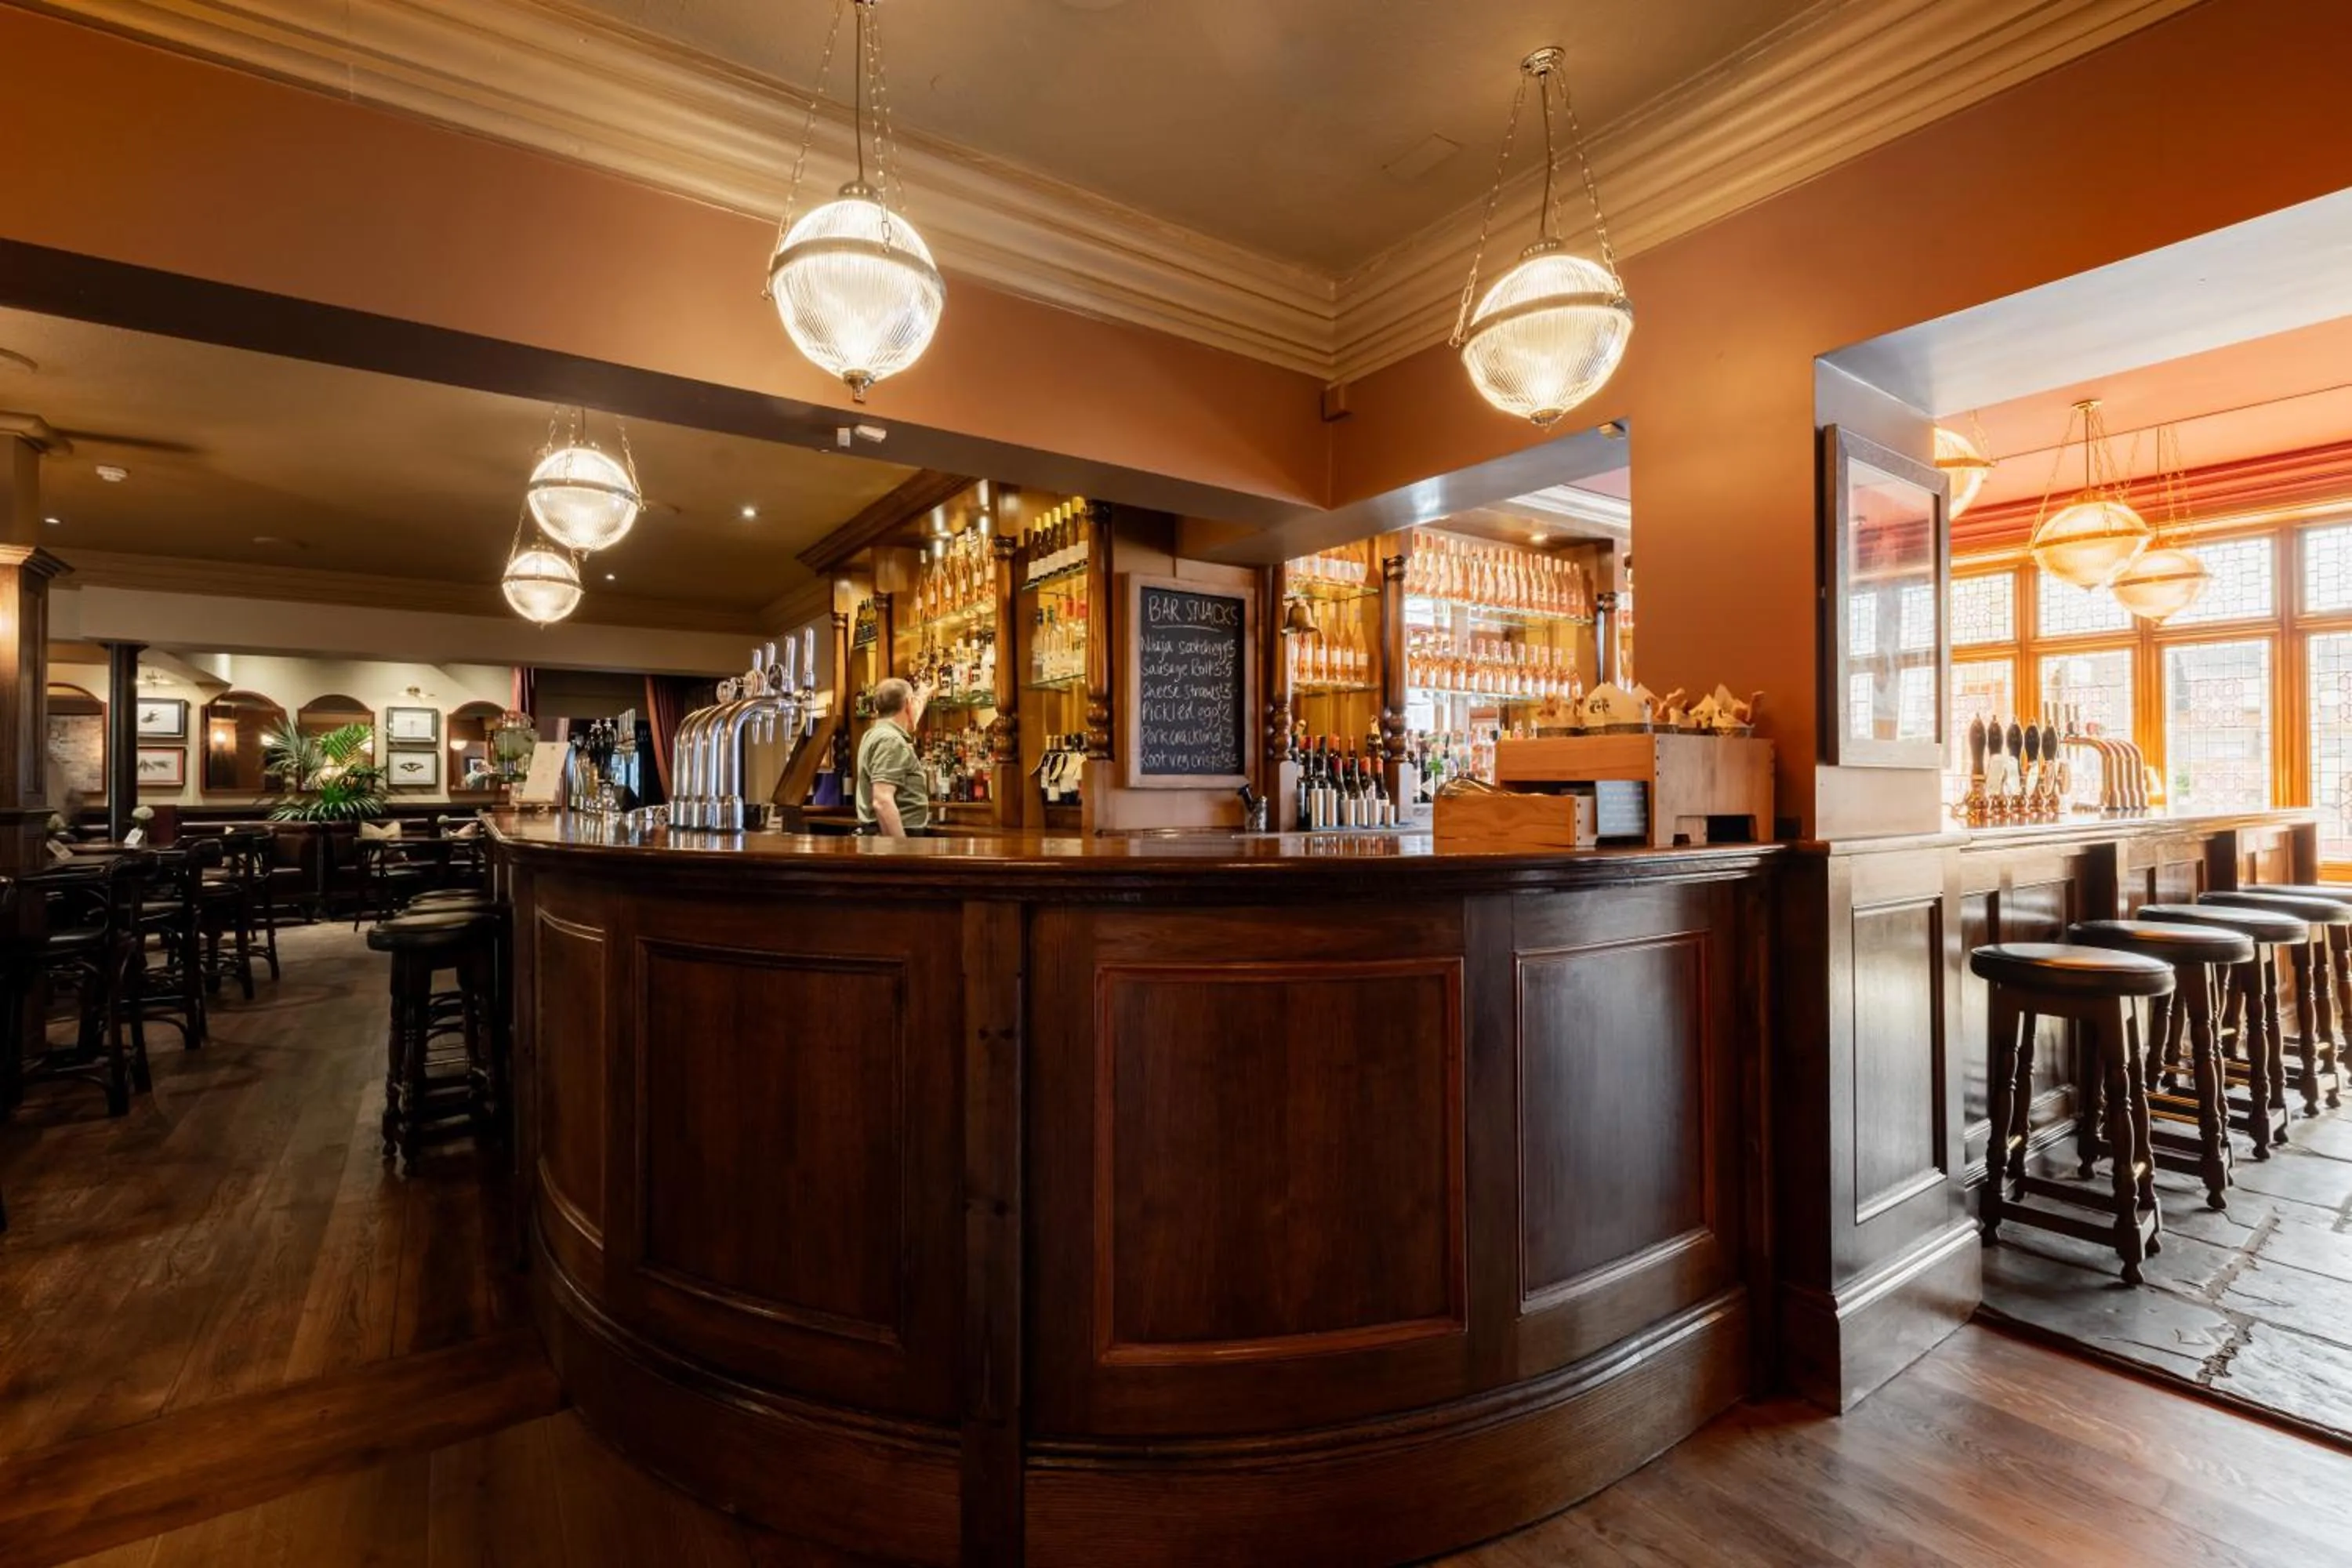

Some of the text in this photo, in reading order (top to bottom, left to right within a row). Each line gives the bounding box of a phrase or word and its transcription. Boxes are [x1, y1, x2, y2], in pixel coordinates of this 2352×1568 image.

[1149, 595, 1239, 626] BAR SNACKS
[1142, 701, 1195, 721] Pickled
[1198, 707, 1221, 729] egg
[1142, 725, 1168, 745] Pork
[1141, 746, 1167, 767] Root
